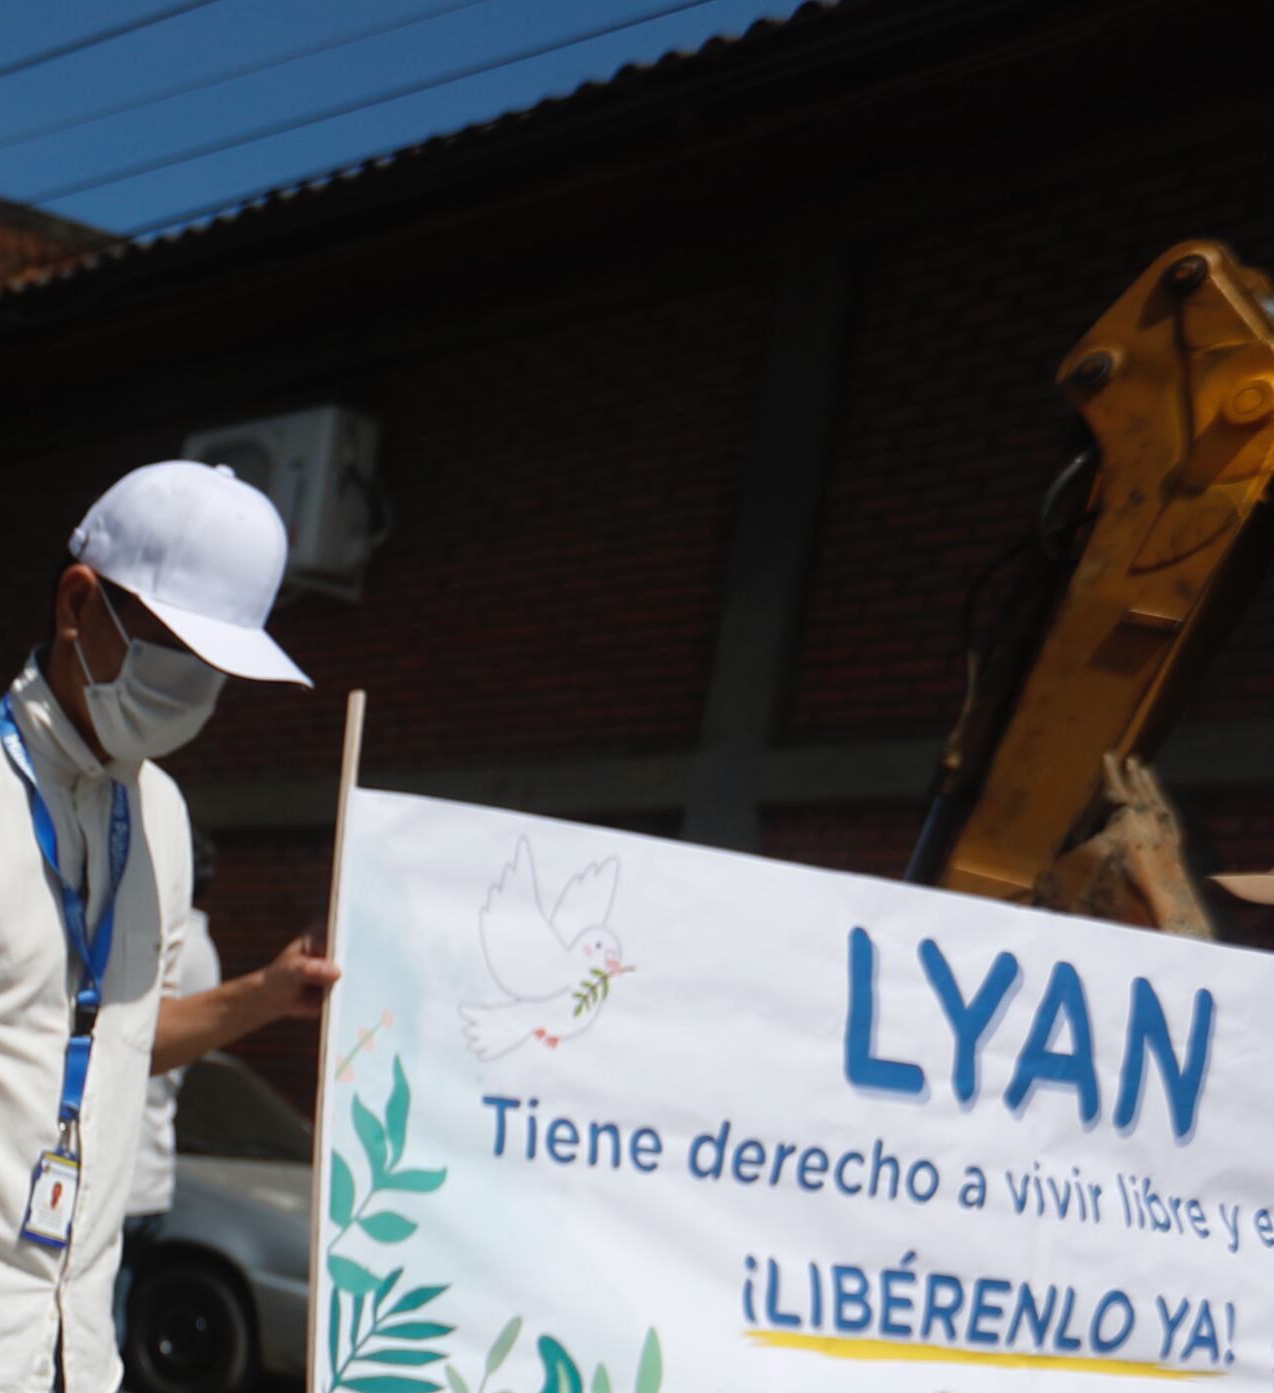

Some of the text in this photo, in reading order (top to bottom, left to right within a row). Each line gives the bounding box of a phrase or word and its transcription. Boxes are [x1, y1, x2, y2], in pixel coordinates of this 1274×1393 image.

[842, 924, 1219, 1144] LYAN
[481, 1095, 662, 1173] Tiene
[688, 1121, 939, 1204] derecho
[958, 1165, 986, 1209] a
[1005, 1161, 1101, 1222] vivir
[1116, 1173, 1210, 1239] libre
[1218, 1203, 1240, 1253] y
[742, 1251, 1236, 1366] ¡LIBÉRENLO YA!
